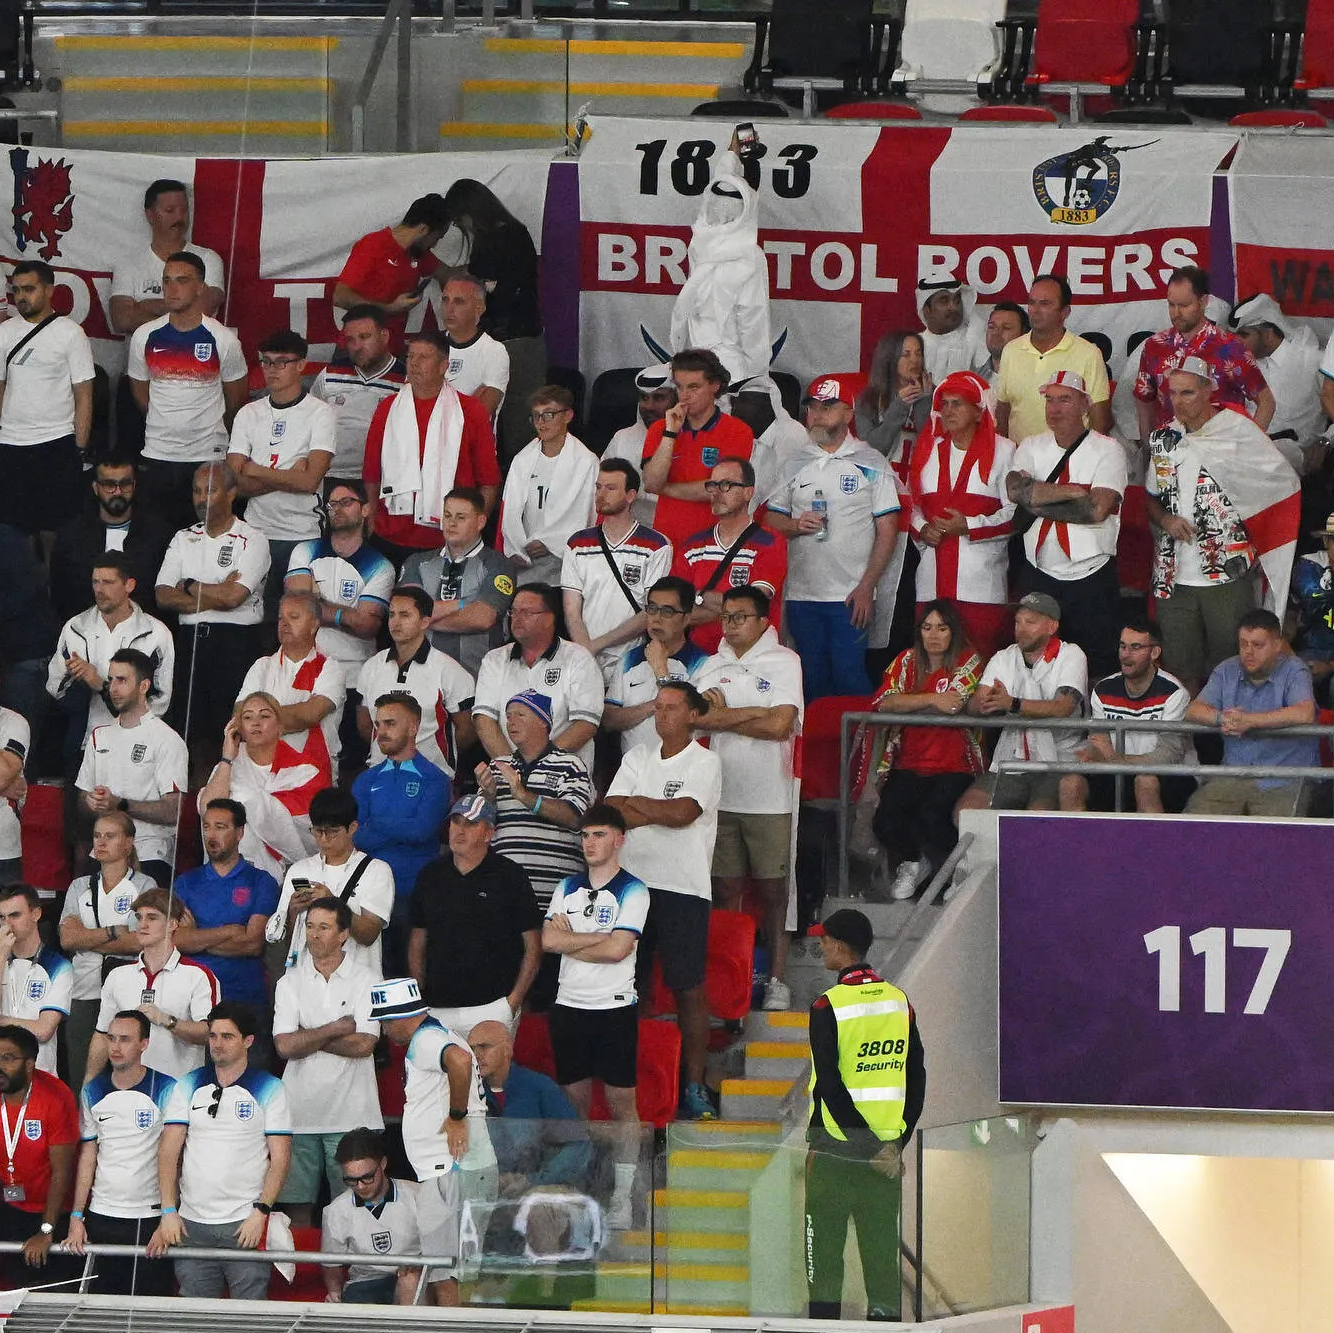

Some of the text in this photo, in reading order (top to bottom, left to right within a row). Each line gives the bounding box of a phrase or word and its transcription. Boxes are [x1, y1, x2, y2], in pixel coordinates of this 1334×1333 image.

[1060, 209, 1089, 221] 1883
[598, 234, 1198, 295] BRTOL ROVERS
[1143, 925, 1292, 1015] 117
[857, 1039, 905, 1058] 3808
[856, 1059, 905, 1073] Security
